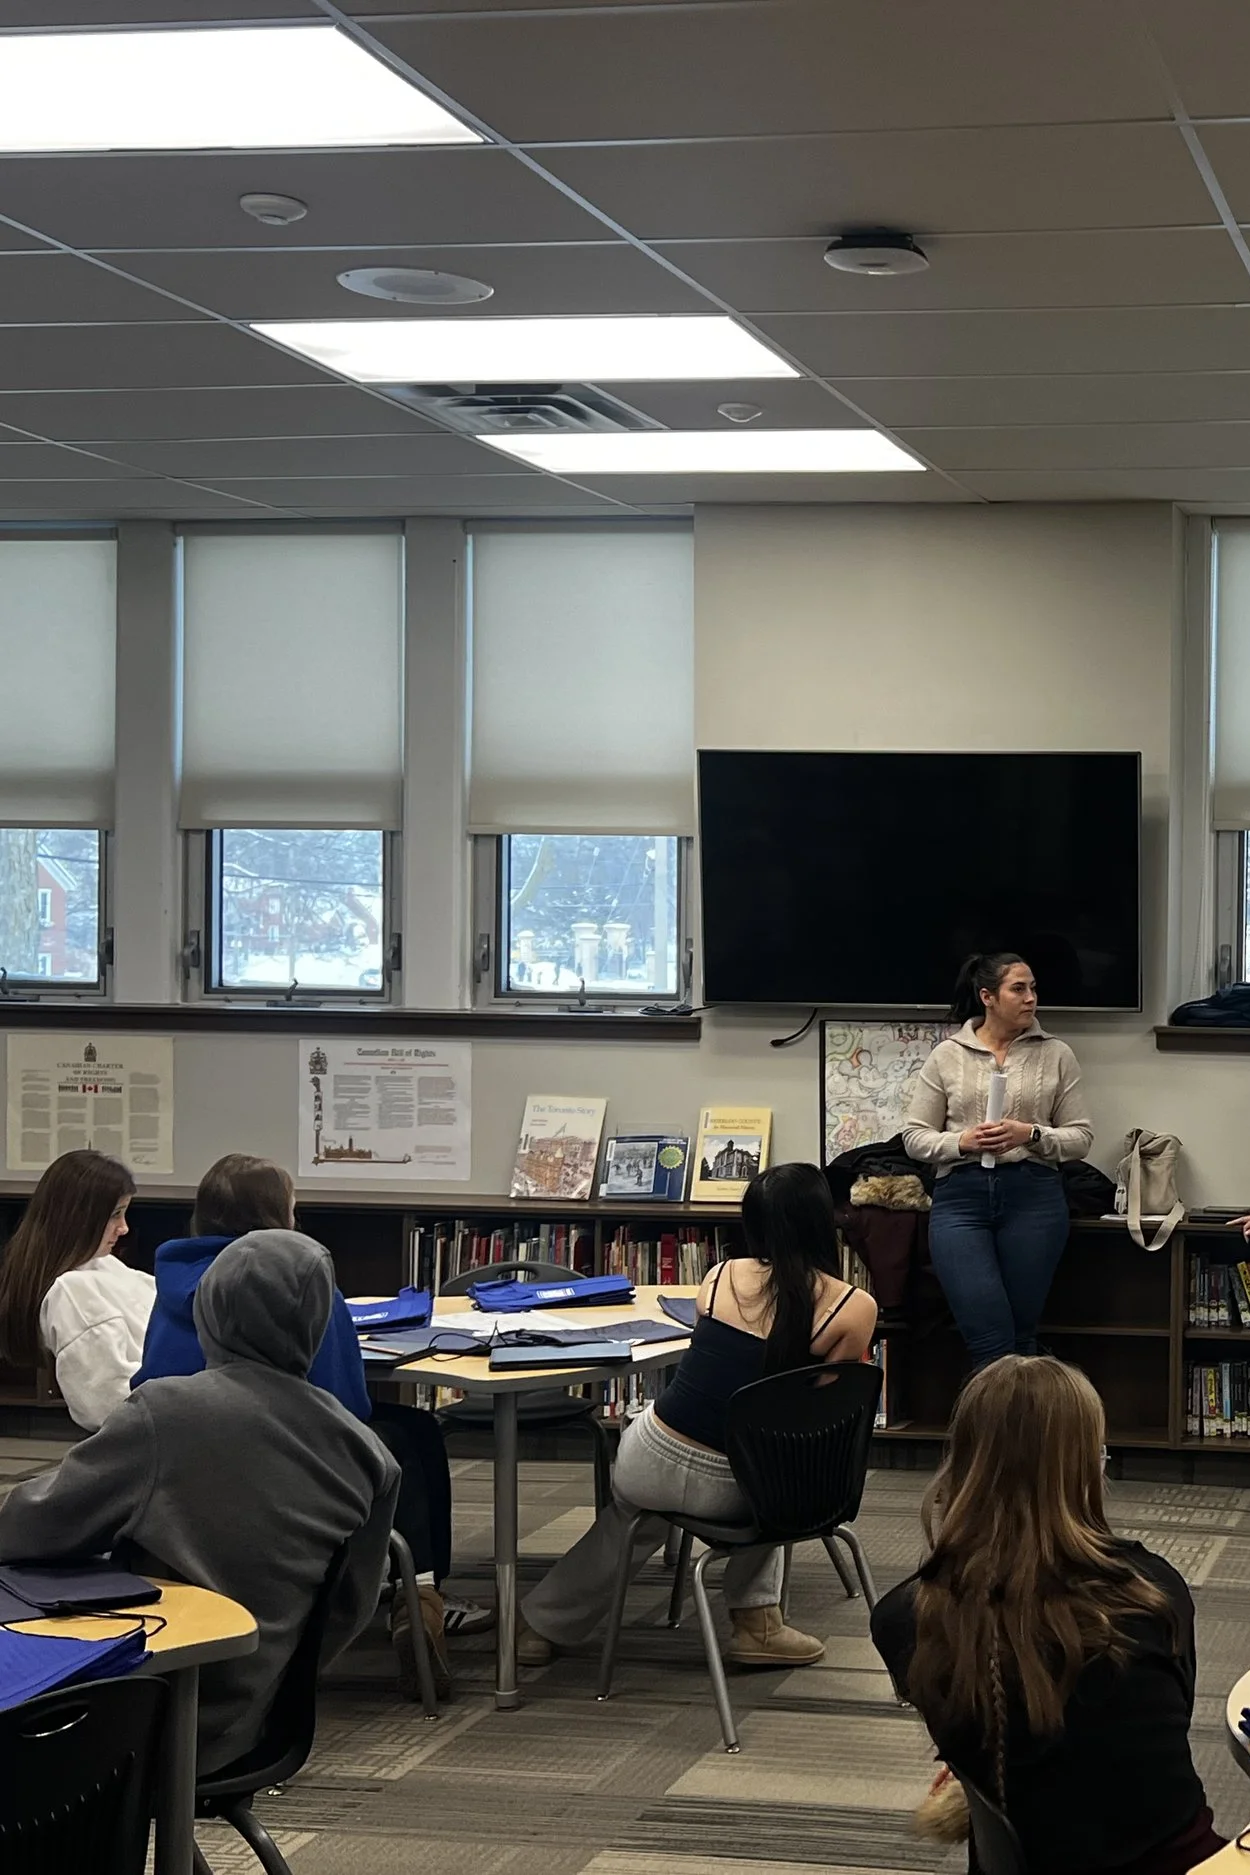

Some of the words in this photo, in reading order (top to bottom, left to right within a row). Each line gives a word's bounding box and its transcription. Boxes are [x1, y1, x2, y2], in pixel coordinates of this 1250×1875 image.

[414, 1049, 436, 1058] Rights
[532, 1105, 546, 1113] The
[547, 1105, 576, 1114] Toronto
[576, 1107, 596, 1117] Story
